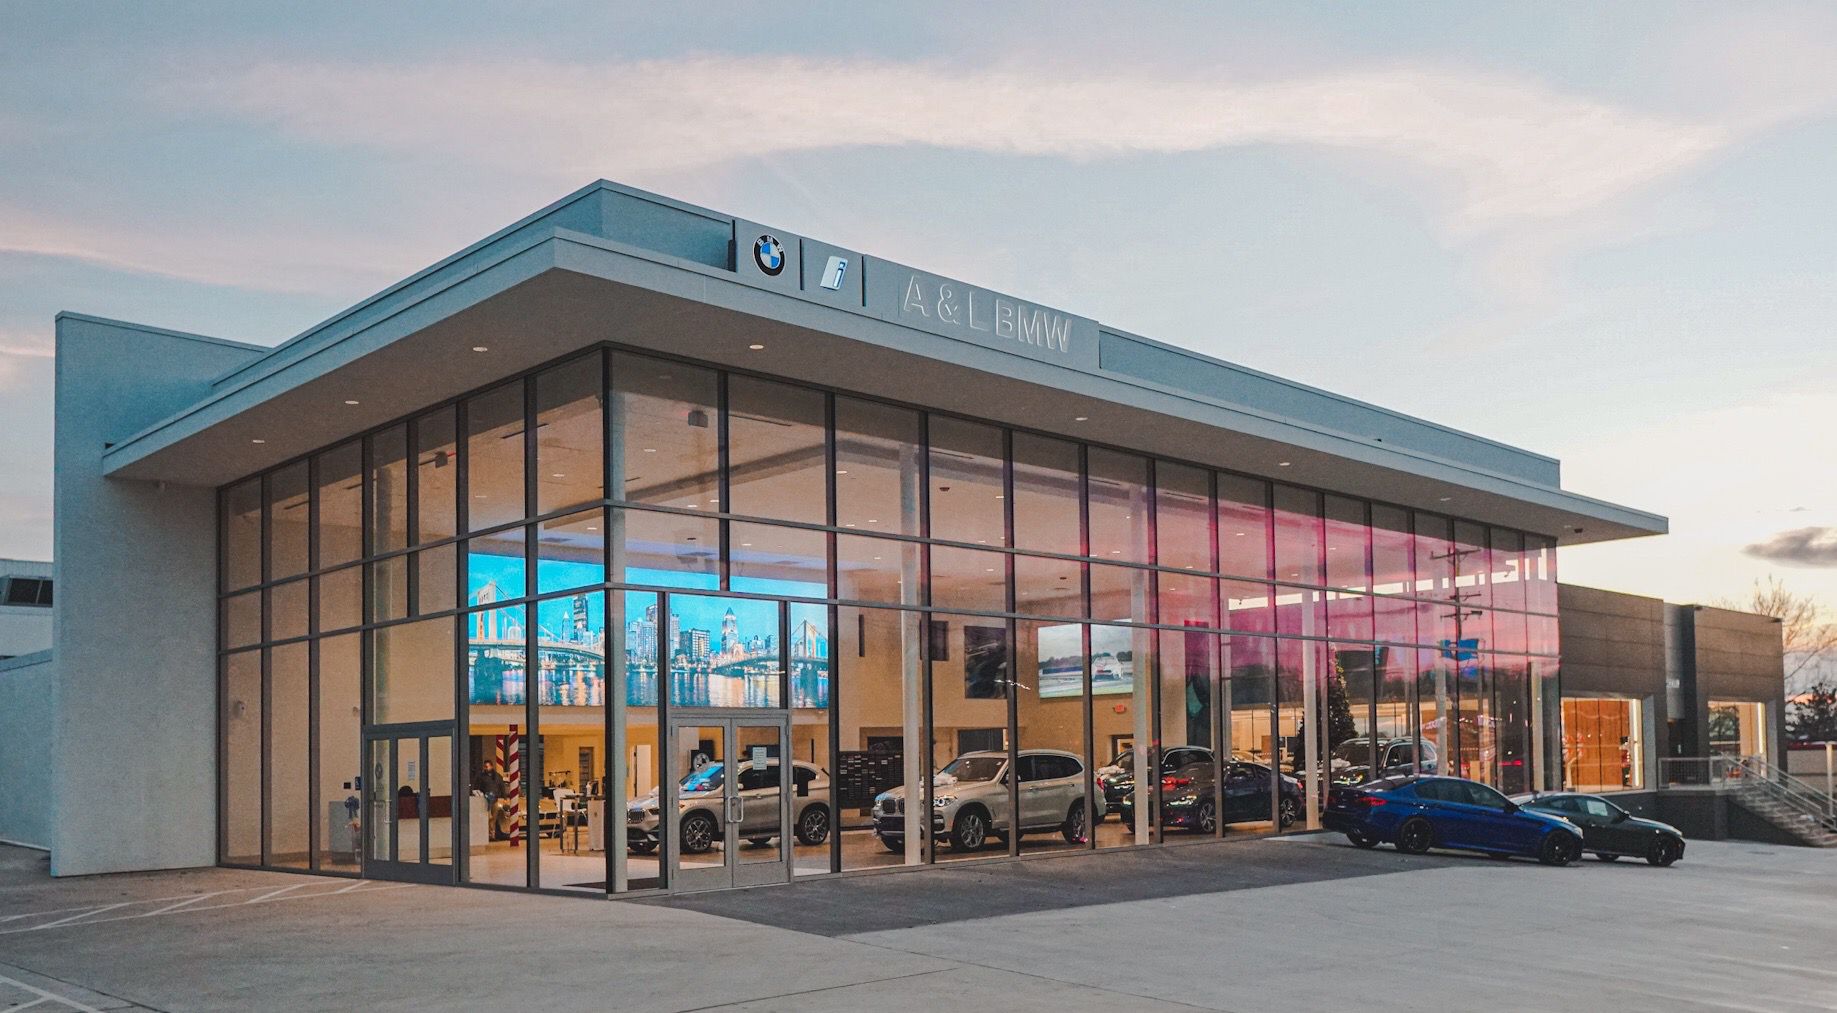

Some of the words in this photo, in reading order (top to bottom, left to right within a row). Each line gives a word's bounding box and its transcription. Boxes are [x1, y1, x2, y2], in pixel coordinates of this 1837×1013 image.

[756, 235, 784, 253] BMW
[903, 274, 930, 318] A
[937, 283, 961, 326] &
[969, 290, 990, 332] L
[995, 298, 1073, 354] BMW
